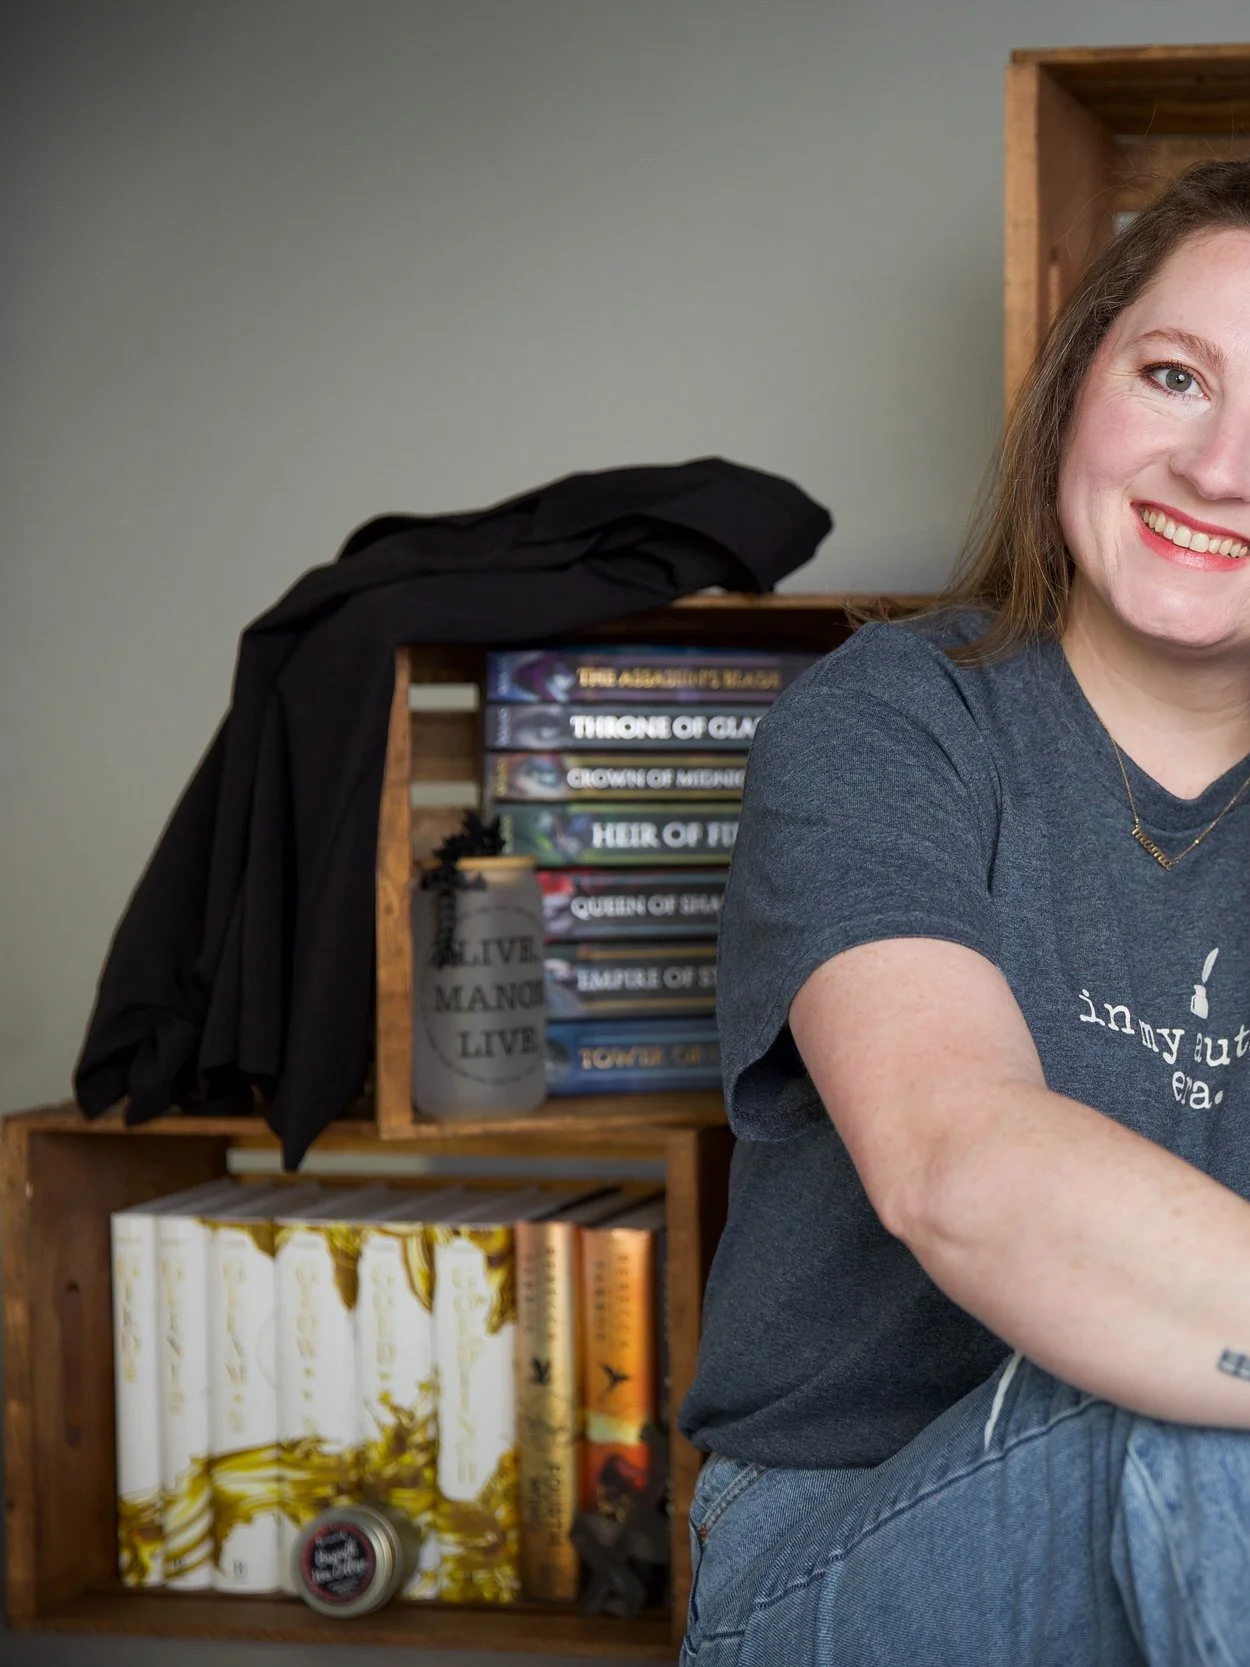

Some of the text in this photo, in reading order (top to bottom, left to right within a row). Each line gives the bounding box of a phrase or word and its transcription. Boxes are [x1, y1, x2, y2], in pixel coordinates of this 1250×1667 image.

[569, 715, 672, 740] THRONE
[672, 715, 707, 740] OF
[566, 768, 646, 790] CROWN
[646, 768, 675, 789] OF
[592, 822, 661, 848] HEIR
[661, 822, 703, 848] OF
[570, 896, 646, 920] QUEEN
[647, 894, 677, 916] OF
[1078, 988, 1135, 1035] in
[1138, 1018, 1185, 1065] my
[1171, 1070, 1224, 1110] era.
